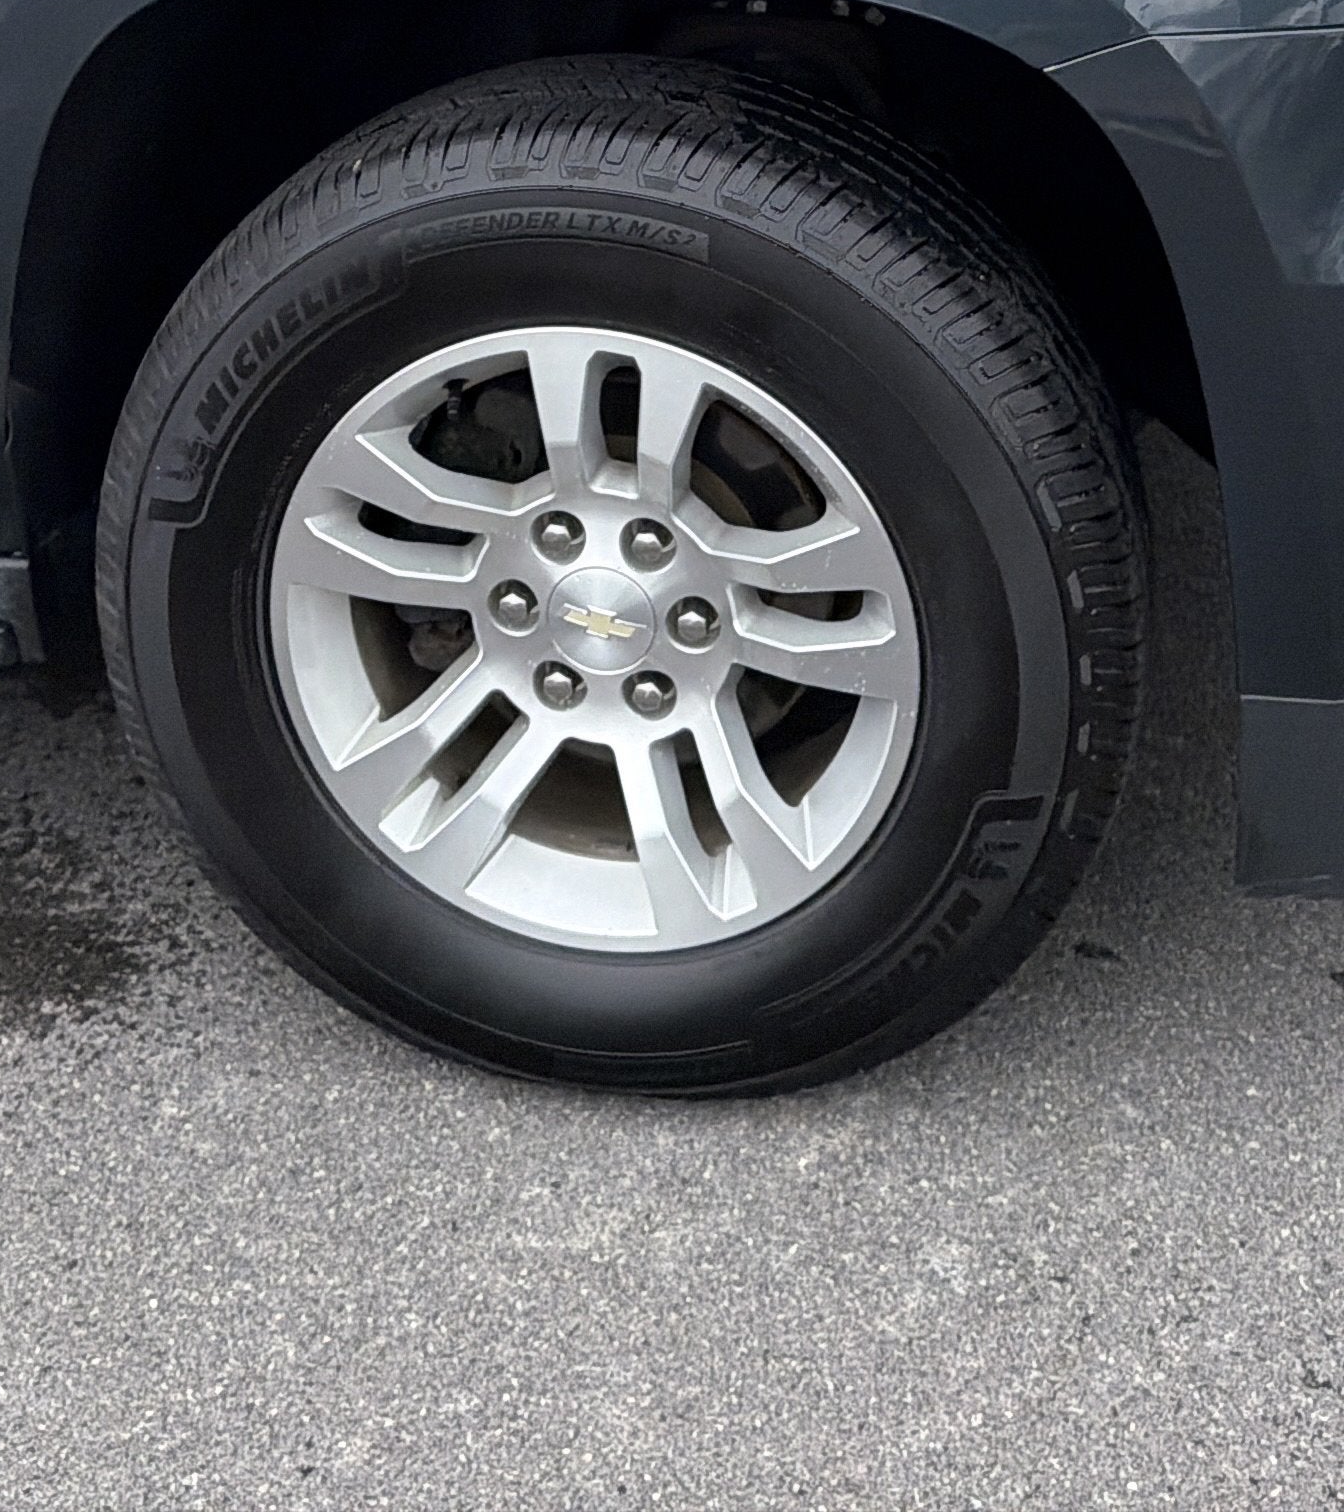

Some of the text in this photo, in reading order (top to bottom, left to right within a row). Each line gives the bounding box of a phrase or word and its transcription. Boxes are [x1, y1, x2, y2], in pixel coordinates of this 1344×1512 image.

[419, 209, 559, 248] DEFENDER
[566, 210, 621, 234] LTX
[193, 254, 372, 436] MICHELIN
